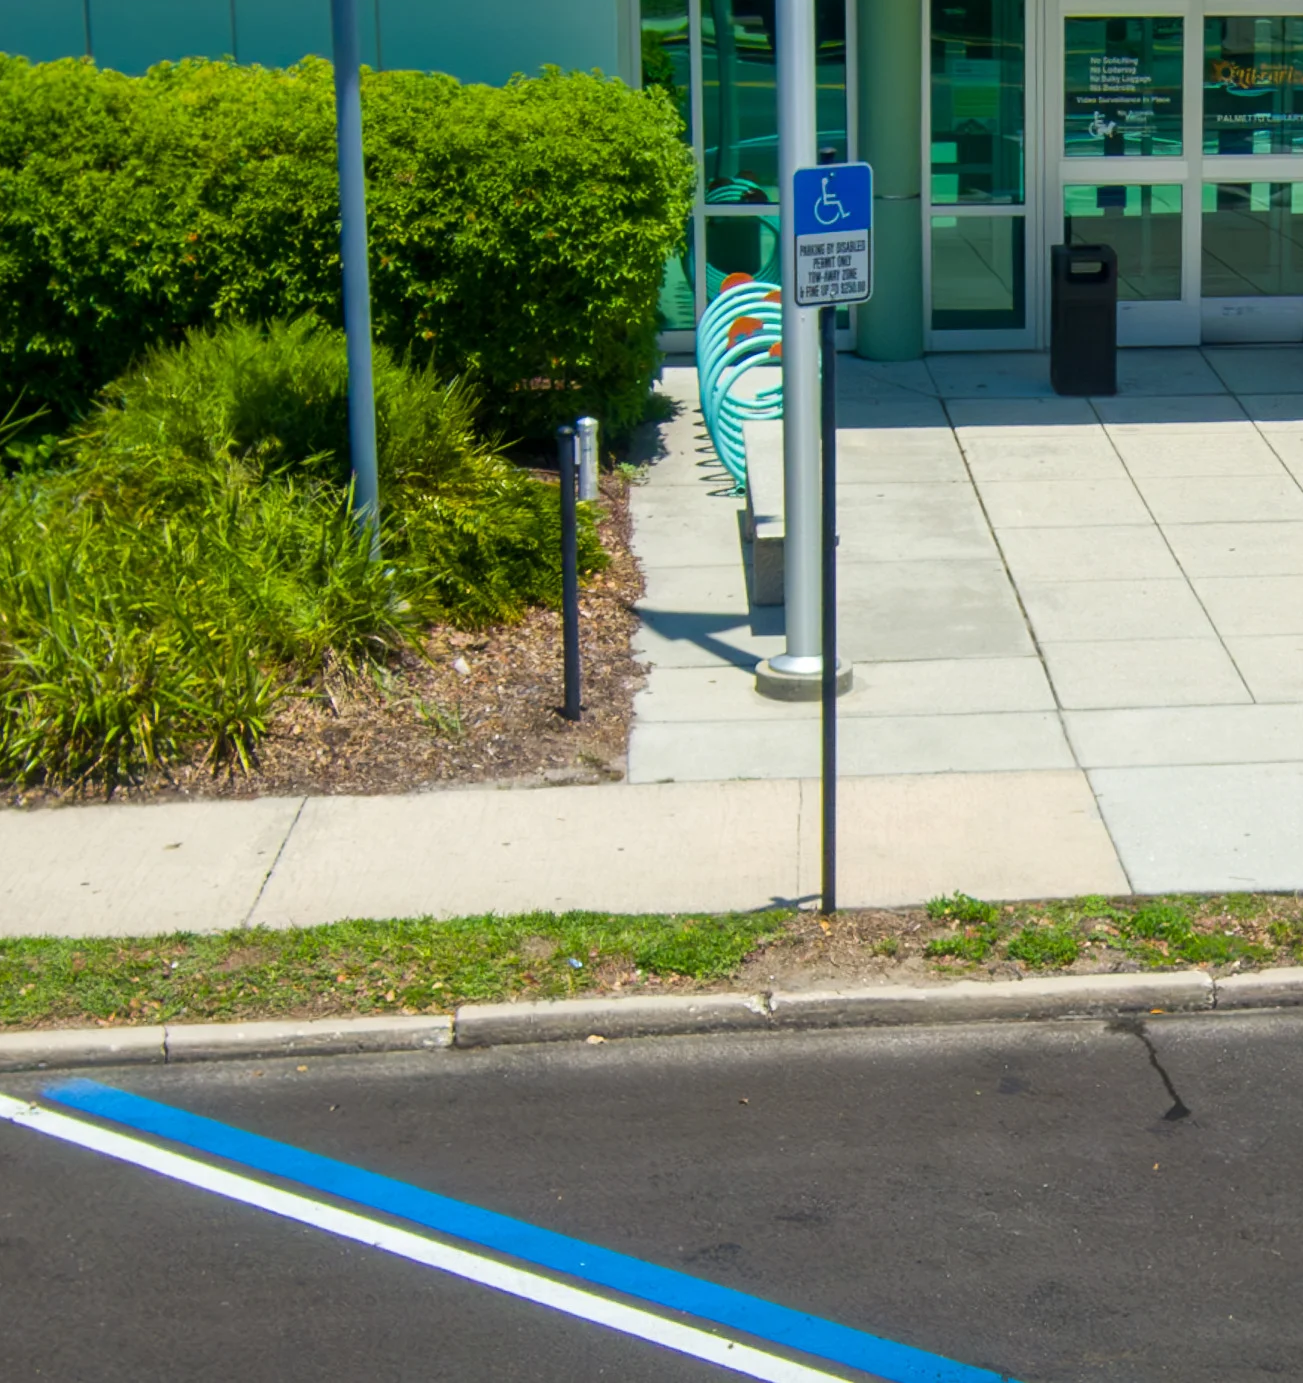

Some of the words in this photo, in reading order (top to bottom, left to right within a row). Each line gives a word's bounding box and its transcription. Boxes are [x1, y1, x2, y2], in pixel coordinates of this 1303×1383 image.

[800, 243, 825, 256] PARKING
[827, 243, 834, 254] BY
[836, 240, 866, 254] DISABLED
[813, 256, 835, 269] PERMIT
[837, 254, 852, 267] ONLY
[808, 269, 840, 283] TOW-AWAY
[842, 267, 858, 280] ZONE
[806, 284, 819, 297] FINE
[820, 284, 829, 296] UP
